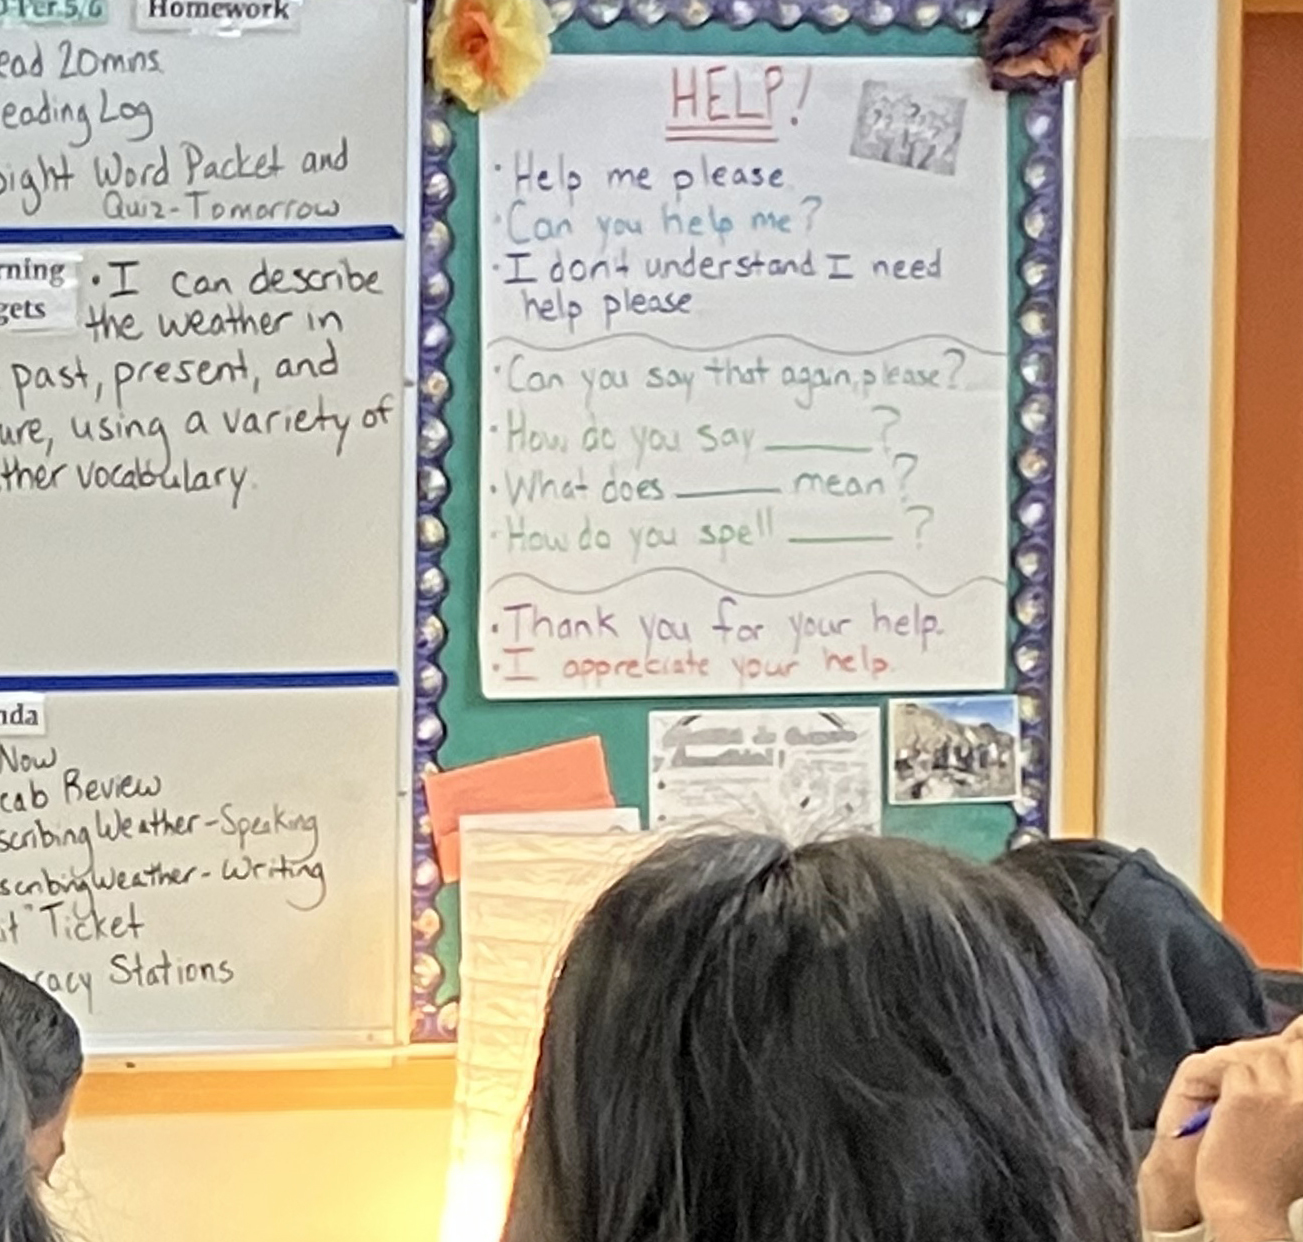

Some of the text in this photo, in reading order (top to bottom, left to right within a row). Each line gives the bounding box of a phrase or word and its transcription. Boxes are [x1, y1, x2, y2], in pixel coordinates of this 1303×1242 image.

[149, 0, 289, 19] Homework
[99, 87, 154, 143] Log
[670, 64, 814, 127] HELP!
[93, 144, 170, 188] Word
[179, 140, 285, 186] Packet
[301, 135, 349, 174] and
[513, 151, 785, 208] Help me please
[506, 198, 574, 246] Can
[595, 214, 644, 254] you
[660, 200, 735, 247] help
[107, 256, 384, 299] I can describe
[502, 251, 538, 285] I
[644, 245, 817, 280] understand
[824, 252, 855, 281] I
[871, 246, 944, 281] need
[84, 301, 344, 343] the weather in
[520, 286, 694, 335] help please
[11, 354, 103, 411] past,
[114, 348, 260, 410] present,
[275, 337, 339, 379] and
[506, 352, 566, 393] Can
[580, 366, 630, 411] you
[645, 365, 695, 404] say
[703, 355, 771, 387] that
[70, 412, 172, 475] using
[184, 409, 210, 435] a
[222, 393, 351, 458] variety
[361, 391, 396, 429] of
[506, 408, 756, 470] How do you say
[504, 466, 589, 508] What
[600, 459, 665, 504] does
[505, 505, 774, 562] How do you spell
[503, 602, 619, 643] Thank
[638, 613, 693, 658] you
[711, 596, 765, 645] for
[788, 609, 852, 655] your
[502, 647, 539, 682] I
[562, 648, 710, 688] appreciate
[730, 656, 800, 688] your
[62, 767, 163, 805] Review
[39, 900, 146, 942] Ticket
[33, 948, 235, 1015] racy Stations
